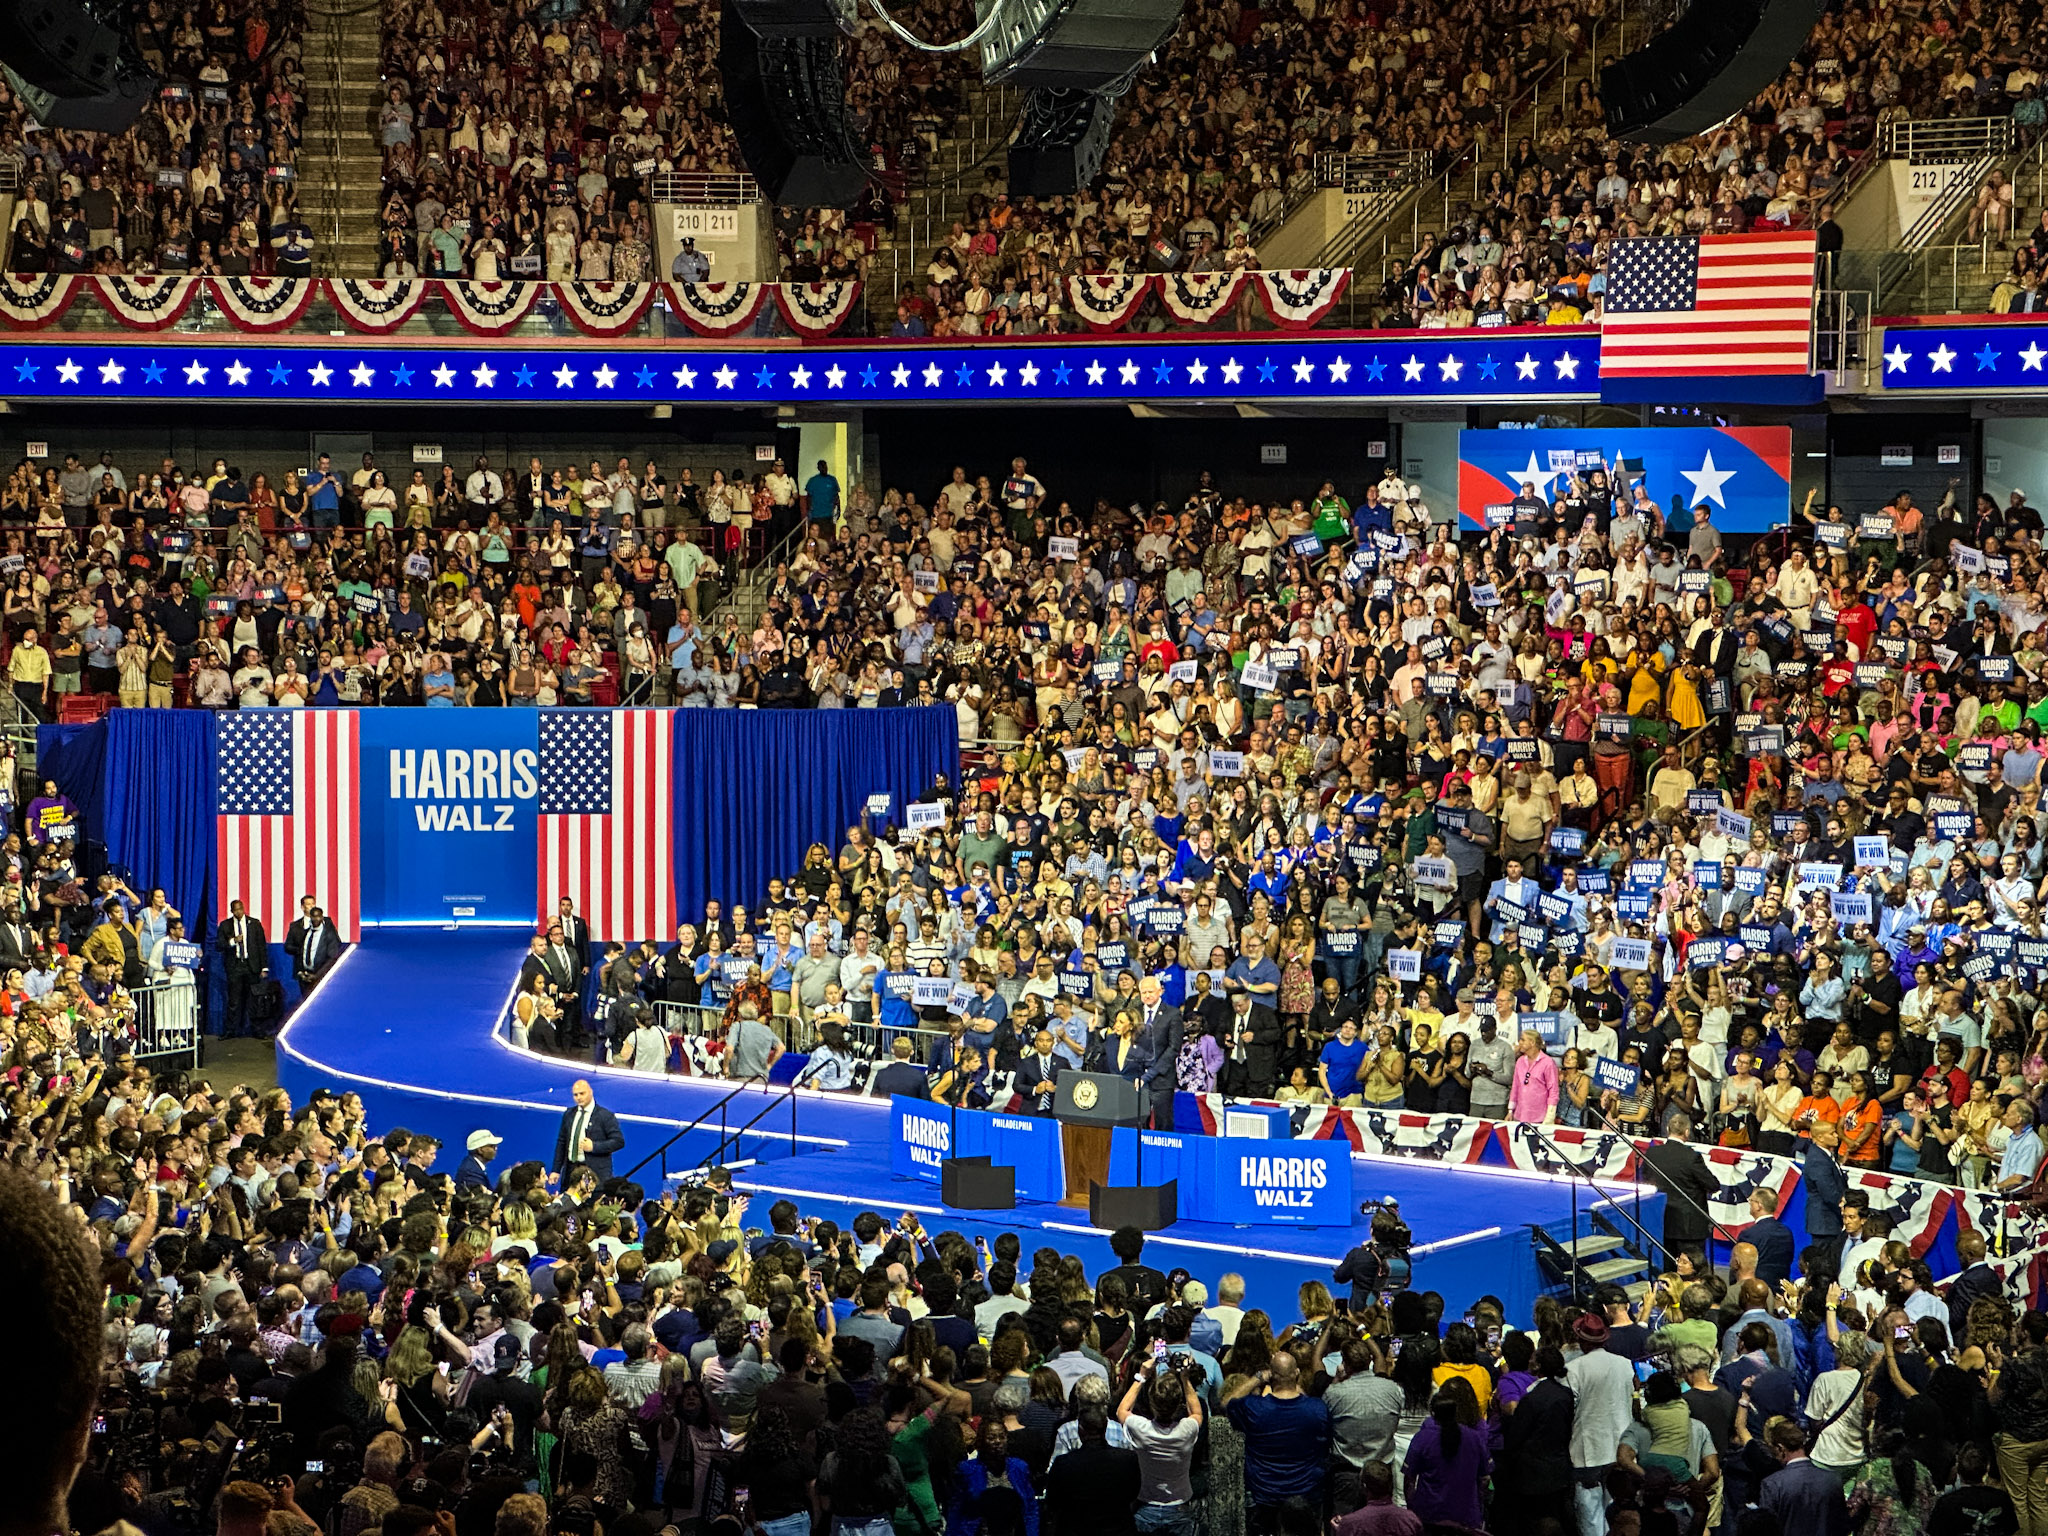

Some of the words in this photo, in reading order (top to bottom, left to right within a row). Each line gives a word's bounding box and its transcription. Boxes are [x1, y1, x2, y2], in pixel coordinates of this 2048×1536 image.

[1913, 171, 1936, 188] 212
[1347, 200, 1364, 214] 211
[678, 216, 699, 229] 210
[711, 216, 733, 229] 211
[1478, 313, 1502, 326] HARRIS
[31, 444, 44, 455] EXIT
[420, 448, 435, 456] 110
[759, 447, 772, 458] EXIT
[1267, 449, 1281, 457] 111
[1370, 444, 1383, 455] EXIT
[1889, 449, 1906, 457] 112
[1942, 449, 1956, 460] EXIT
[1577, 455, 1586, 465] WE
[1587, 454, 1600, 465] WIN
[1487, 507, 1513, 517] HARRIS
[1864, 518, 1891, 528] HARRIS
[1818, 526, 1844, 537] HARRIS
[1868, 527, 1886, 535] WALZ
[1822, 535, 1839, 543] WALZ
[1682, 573, 1709, 583] HARRIS
[1803, 633, 1831, 644] HARRIS
[1270, 651, 1298, 662] HARRIS
[1094, 663, 1120, 675] HARRIS
[1777, 662, 1807, 671] HARRIS
[1980, 660, 2009, 670] HARRIS
[1179, 668, 1193, 679] WIN
[1247, 670, 1256, 679] WE
[1258, 672, 1273, 683] WIN
[1857, 666, 1886, 677] HARRIS
[1428, 676, 1456, 687] HARRIS
[1736, 714, 1761, 726] HARRIS
[1601, 722, 1612, 733] WE
[1613, 722, 1629, 733] WIN
[1508, 742, 1535, 753] HARRIS
[1749, 740, 1761, 751] WE
[1762, 739, 1777, 749] WIN
[1135, 751, 1156, 763] HARRIS
[1962, 748, 1989, 759] HARRIS
[1214, 760, 1223, 770] WE
[1225, 760, 1239, 769] WIN
[390, 749, 537, 798] HARRIS
[867, 795, 890, 806] HARRIS
[1689, 798, 1702, 809] WE
[1703, 799, 1718, 809] WIN
[415, 805, 514, 831] WALZ
[912, 813, 926, 822] WE
[927, 811, 940, 821] WIN
[1437, 813, 1448, 824] WE
[1450, 815, 1465, 827] WIN
[1938, 815, 1970, 829] HARRIS
[1720, 817, 1729, 828] WE
[1730, 821, 1745, 834] WIN
[1945, 828, 1966, 836] WALZ
[1551, 835, 1561, 845] WE
[1563, 836, 1580, 848] WIN
[1349, 847, 1378, 859] HARRIS
[1859, 847, 1868, 858] WE
[1870, 846, 1884, 857] WIN
[1353, 858, 1373, 866] WALZ
[1418, 867, 1429, 876] WE
[1431, 867, 1446, 878] WIN
[1632, 864, 1661, 875] HARRIS
[1701, 870, 1716, 882] WIN
[1735, 870, 1761, 883] ARRIS
[1804, 873, 1816, 884] WE
[1817, 873, 1835, 884] WIN
[1590, 878, 1607, 890] WIN
[1497, 900, 1526, 920] HARRIS
[1539, 894, 1569, 915] HARRIS
[1619, 900, 1630, 911] WE
[1631, 900, 1647, 911] WIN
[1835, 903, 1848, 914] WE
[1850, 903, 1866, 916] WIN
[1150, 911, 1182, 924] HARRIS
[1155, 923, 1177, 931] WALZ
[1434, 923, 1461, 935] HARRIS
[1326, 933, 1357, 945] HARRIS
[1437, 935, 1455, 943] WALZ
[1741, 928, 1769, 942] HARRIS
[1746, 940, 1766, 949] WALZ
[1981, 934, 2011, 948] HARRIS
[166, 944, 196, 958] HARRIS
[1098, 945, 1125, 959] HARRIS
[1333, 944, 1353, 952] WALZ
[1688, 941, 1721, 956] HARRIS
[171, 956, 190, 964] WALZ
[1616, 949, 1626, 958] WE
[1628, 950, 1645, 960] WIN
[1694, 955, 1716, 964] WALZ
[2023, 955, 2043, 964] WALZ
[1400, 960, 1415, 972] WIN
[1060, 975, 1088, 988] HARRIS
[918, 987, 931, 997] WE
[932, 987, 949, 997] WIN
[954, 997, 966, 1008] WE
[1475, 1003, 1496, 1015] HARR
[1522, 1022, 1534, 1031] WE
[1536, 1022, 1555, 1033] WIN
[1600, 1063, 1635, 1084] HARRIS
[1604, 1077, 1627, 1090] WALZ
[993, 1118, 1032, 1130] PHILADELPHIA
[903, 1114, 949, 1151] HARRIS
[1141, 1131, 1168, 1148] PHILADELPHIA
[911, 1146, 941, 1167] WALZ
[1241, 1157, 1326, 1188] HARRIS
[1255, 1190, 1312, 1207] WALZ
